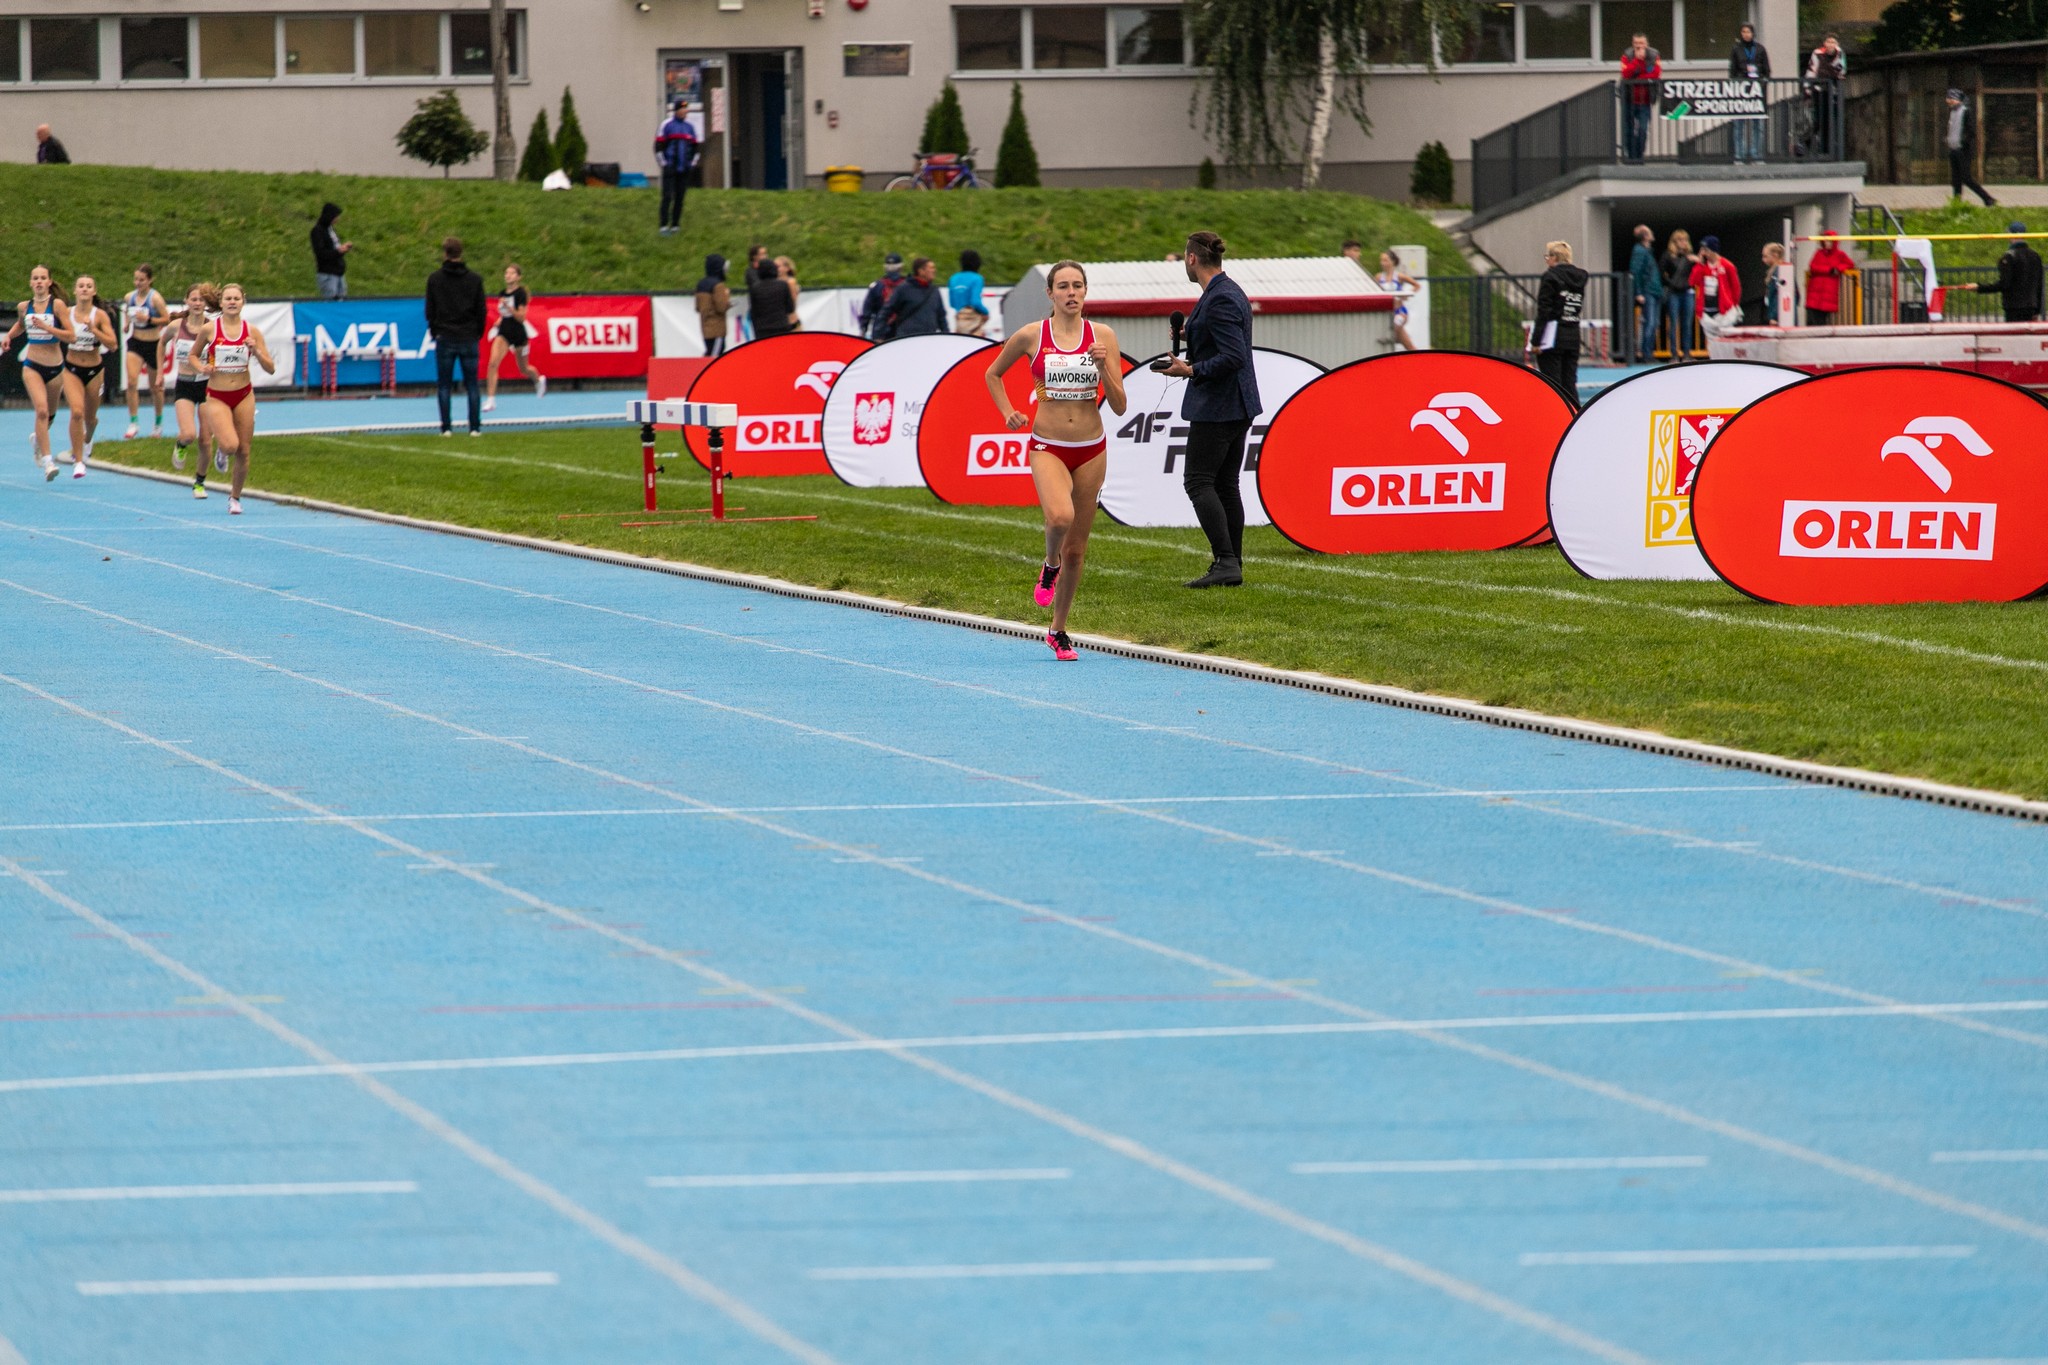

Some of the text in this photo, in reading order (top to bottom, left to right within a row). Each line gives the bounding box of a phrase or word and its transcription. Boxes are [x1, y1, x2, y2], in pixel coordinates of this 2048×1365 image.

[1664, 80, 1763, 98] STRZELNICA
[1694, 99, 1765, 113] SPORTOWA
[556, 323, 631, 346] ORLEN
[1080, 356, 1094, 366] 25
[1048, 372, 1097, 383] JAWORSKA
[1051, 391, 1078, 399] KRAKÓW
[1116, 411, 1173, 443] 4F
[1341, 471, 1493, 507] ORLEN
[1793, 509, 1981, 551] ORLEN
